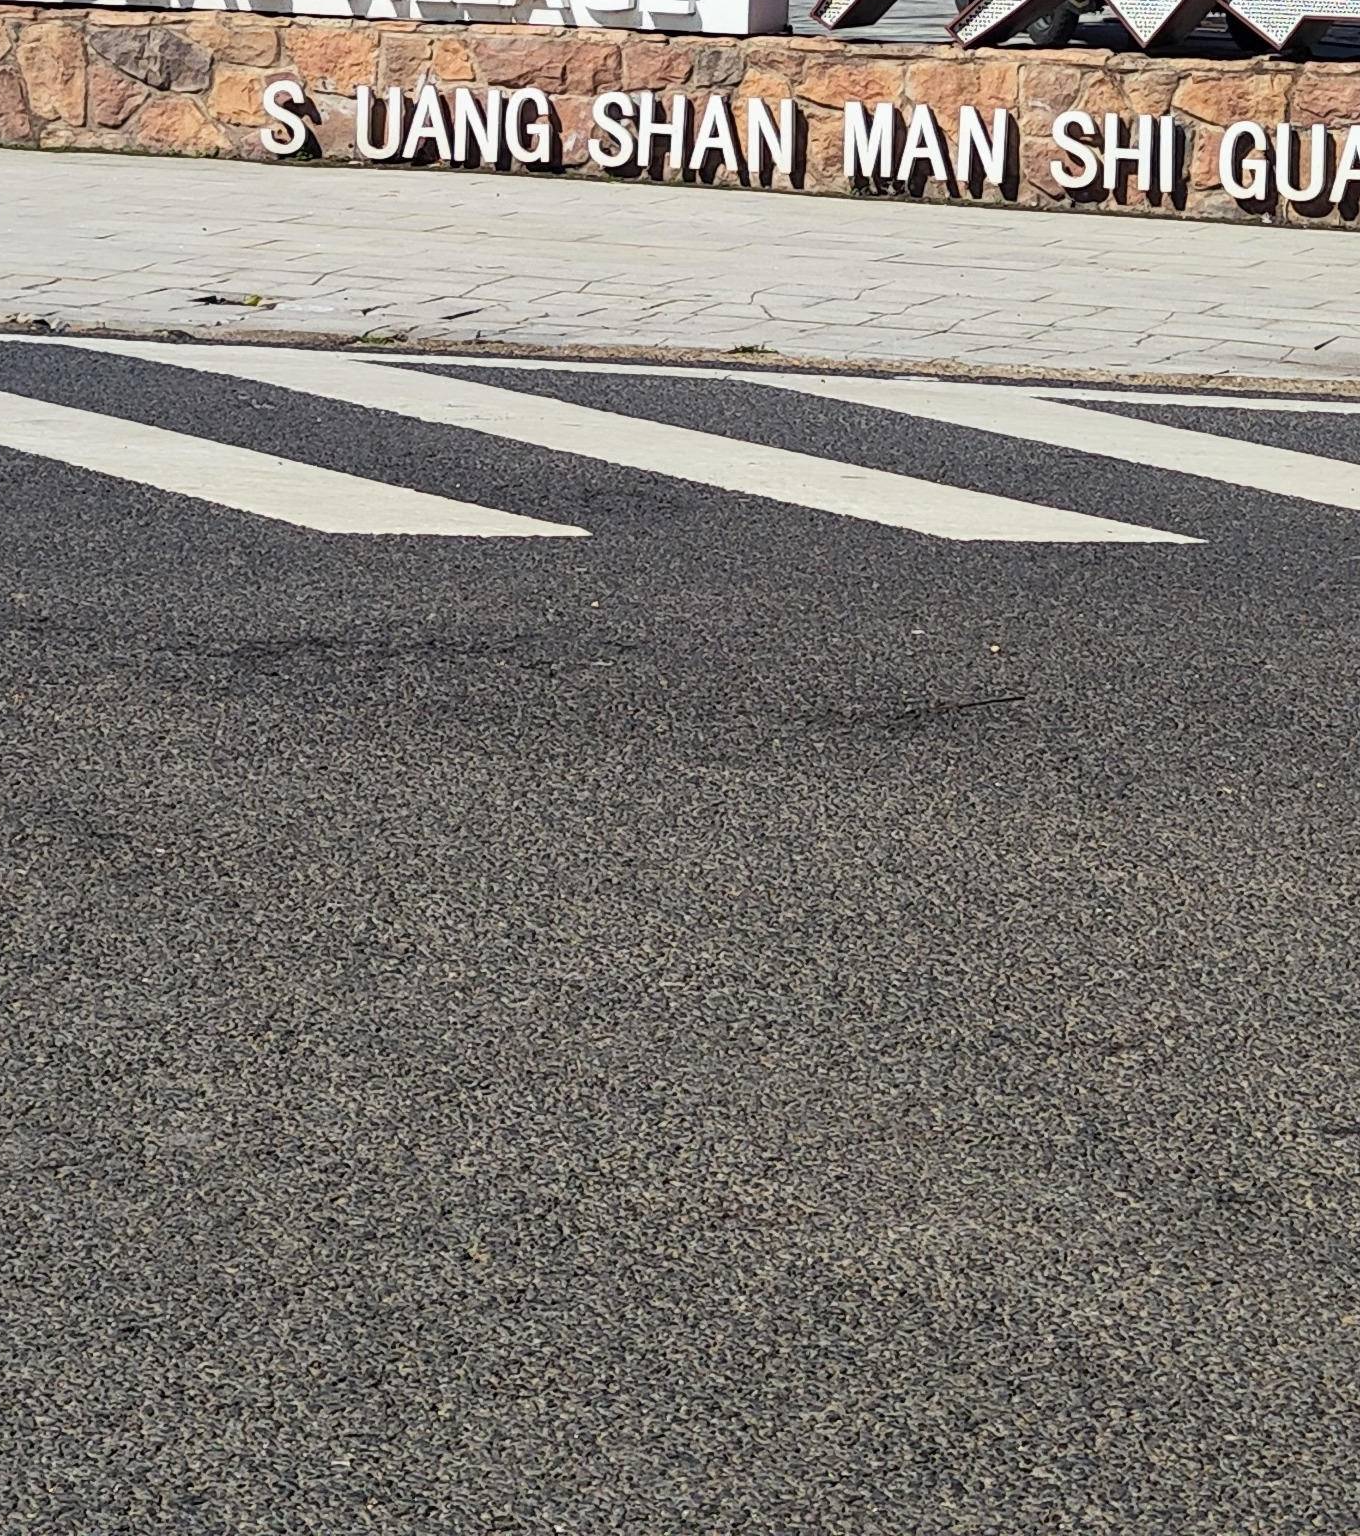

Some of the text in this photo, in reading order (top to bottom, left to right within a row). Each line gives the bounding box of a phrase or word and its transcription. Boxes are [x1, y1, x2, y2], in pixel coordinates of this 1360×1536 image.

[589, 91, 793, 176] SHAN
[843, 99, 1010, 185] MAN
[1050, 110, 1175, 193] SHI
